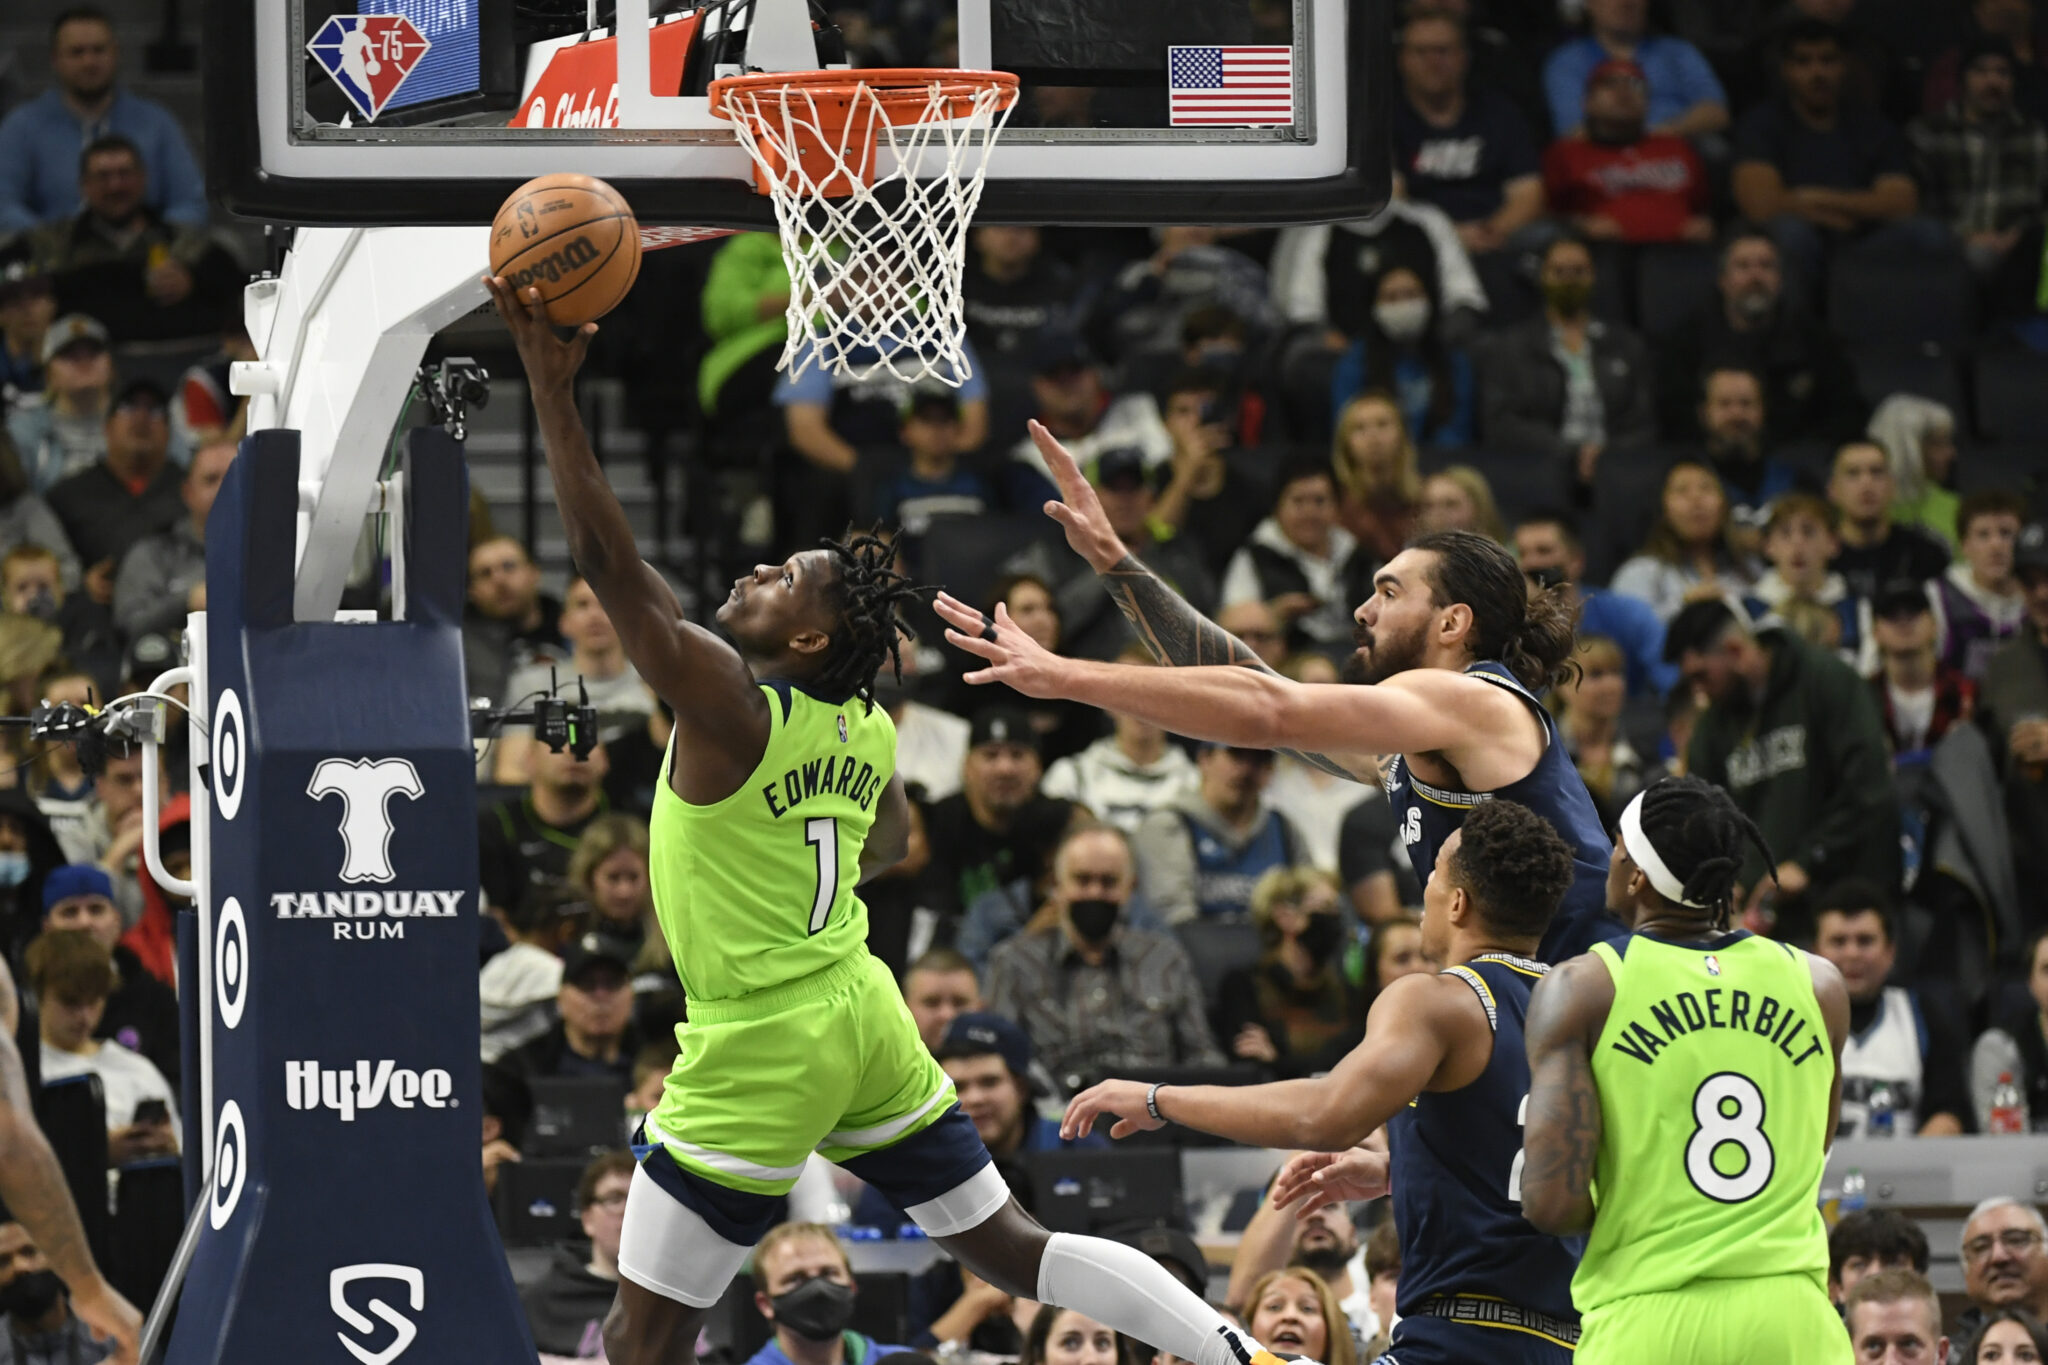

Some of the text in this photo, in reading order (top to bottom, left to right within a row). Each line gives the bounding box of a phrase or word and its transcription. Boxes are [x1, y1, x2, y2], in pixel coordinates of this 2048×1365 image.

[379, 30, 403, 61] 75
[505, 235, 600, 291] Wilson
[762, 755, 881, 819] EDWARDS
[270, 890, 465, 919] TANDUAY
[804, 816, 839, 937] 1
[333, 921, 405, 940] RUM
[1612, 988, 1824, 1066] VANDERBILT
[1683, 1070, 1776, 1204] 8
